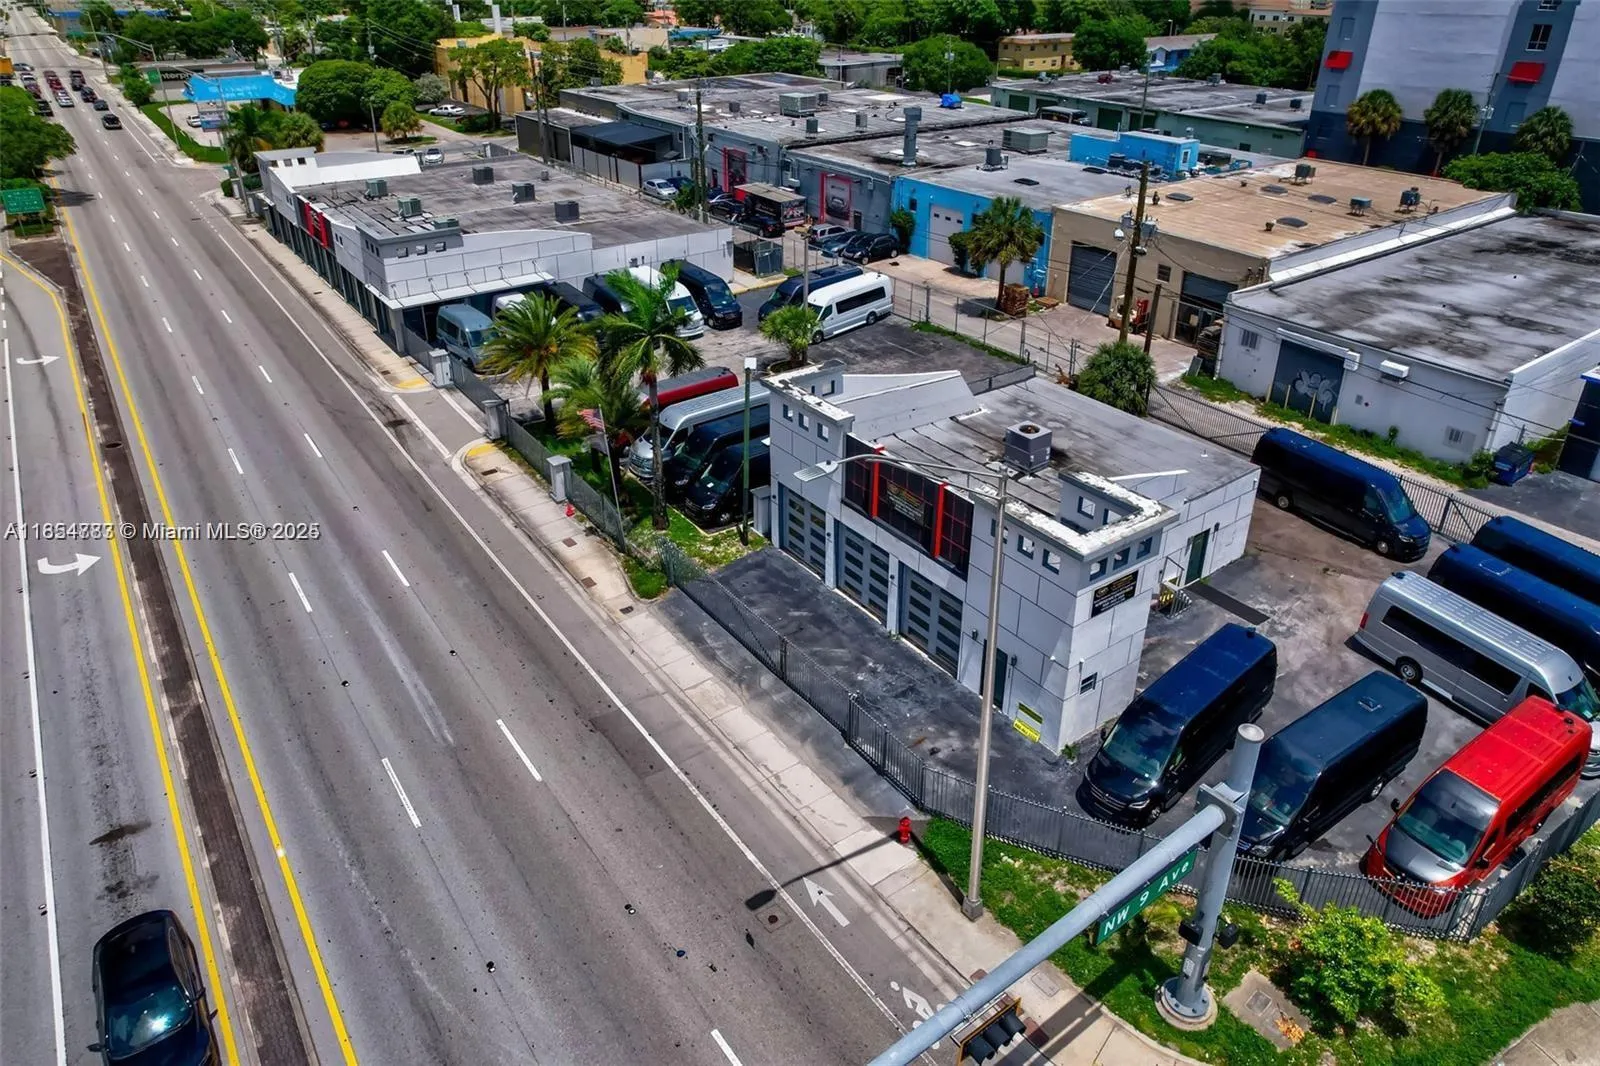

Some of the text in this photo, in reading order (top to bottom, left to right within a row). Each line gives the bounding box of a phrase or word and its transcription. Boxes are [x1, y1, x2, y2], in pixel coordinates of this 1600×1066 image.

[1104, 861, 1190, 936] NW 9 Ave
